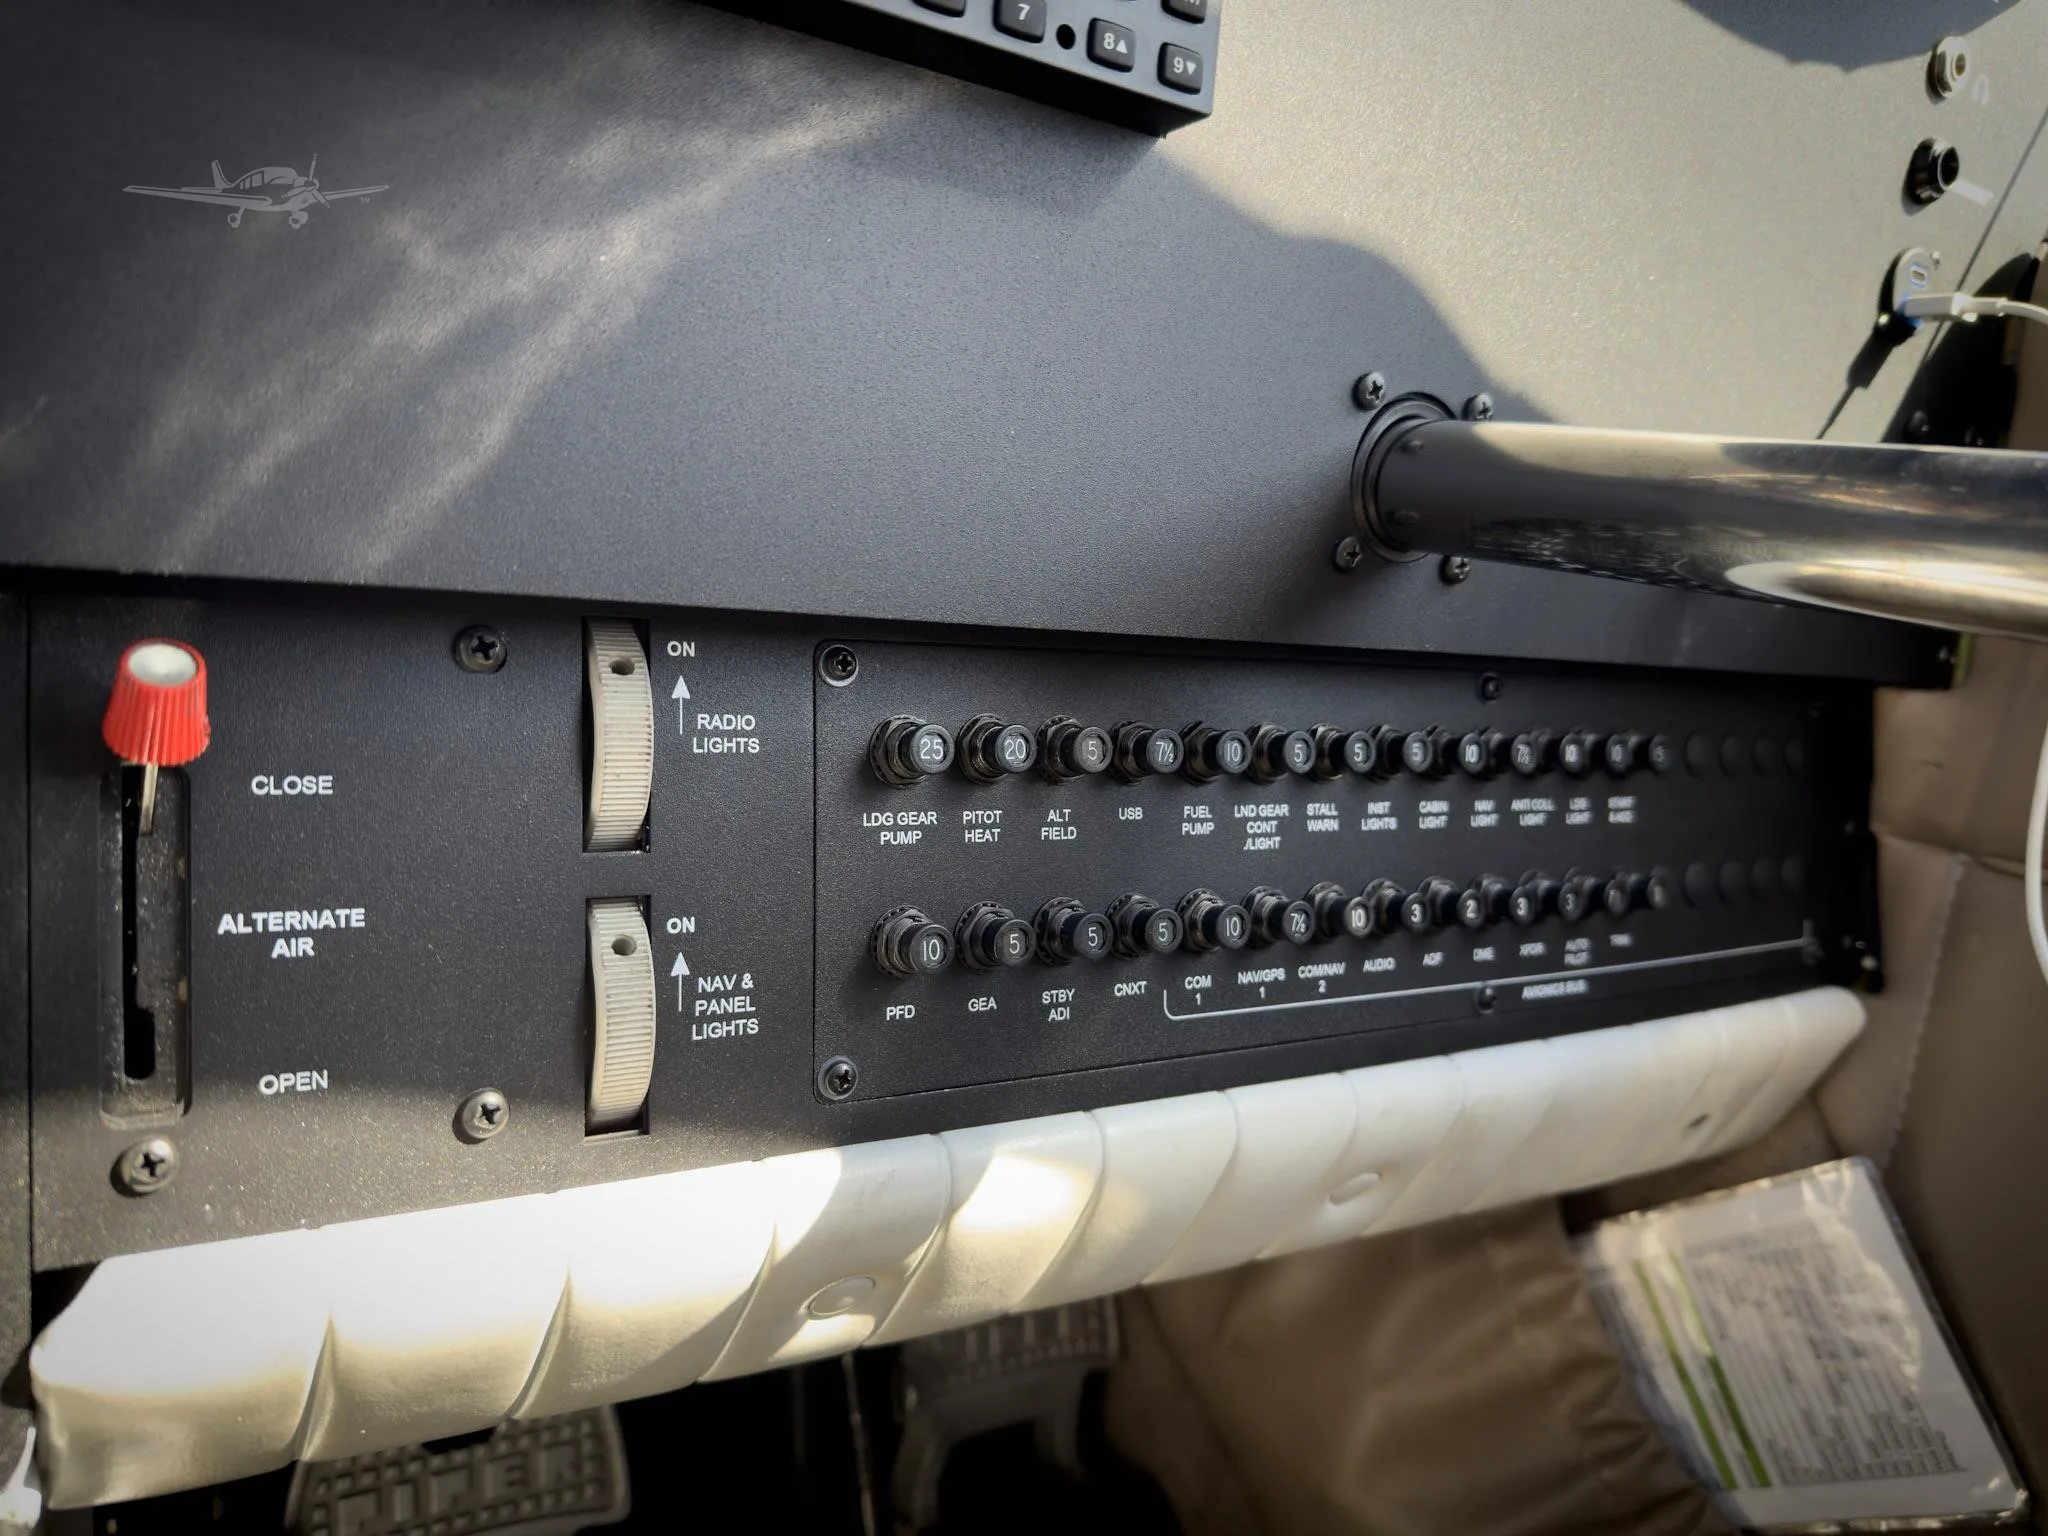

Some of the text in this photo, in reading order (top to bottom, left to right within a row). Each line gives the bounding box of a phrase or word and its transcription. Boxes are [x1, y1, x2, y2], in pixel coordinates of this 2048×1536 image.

[1019, 4, 1030, 20] 7
[1104, 33, 1115, 49] 8
[1174, 57, 1183, 73] 9
[667, 641, 695, 657] ON
[698, 714, 755, 730] RADIO
[693, 736, 759, 754] LIGHTS
[920, 736, 943, 760] 25
[1005, 736, 1025, 759] 20
[1088, 741, 1097, 760] 5
[1228, 743, 1240, 761] 10
[1294, 744, 1302, 762] 5
[1354, 744, 1362, 761] 5
[1413, 743, 1421, 761] 5
[1466, 745, 1478, 763] 10
[252, 775, 333, 795] CLOSE
[1047, 809, 1071, 822] ALT
[1119, 807, 1143, 819] USB
[1184, 806, 1212, 818] FUEL
[1235, 804, 1288, 817] LND GEAR
[1307, 803, 1338, 816] STALL
[1368, 802, 1390, 814] INST
[863, 812, 937, 826] LDG GEAR
[963, 811, 1002, 824] PITOT
[1307, 819, 1338, 831] WARN
[1362, 817, 1397, 830] LIGHTS
[1419, 815, 1447, 829] LIGHT
[1471, 814, 1498, 827] LIGHT
[1042, 827, 1076, 840] FIELD
[1182, 822, 1214, 835] PUMP
[1247, 821, 1277, 833] CONT
[881, 831, 922, 845] PUMP
[965, 829, 1000, 842] HEAT
[218, 908, 365, 934] ALTERNATE
[1352, 909, 1364, 927] 10
[1411, 904, 1421, 922] 3
[667, 917, 695, 934] ON
[1159, 923, 1168, 941] 5
[1227, 917, 1239, 936] 10
[1010, 934, 1019, 953] 5
[1089, 927, 1097, 946] 5
[272, 937, 314, 958] AIR
[924, 939, 940, 960] 10
[1298, 963, 1345, 978] COM/NAV
[1363, 958, 1395, 971] AUDIO
[699, 973, 753, 993] NAV &
[1185, 975, 1211, 989] COM
[1238, 968, 1285, 984] NAV/GPS
[1114, 981, 1147, 996] CNXT
[1259, 986, 1264, 998] 1
[1319, 980, 1325, 992] 2
[968, 997, 997, 1011] GEA
[1043, 989, 1075, 1003] STBY
[1196, 993, 1200, 1005] 1
[696, 996, 756, 1016] PANEL
[887, 1005, 915, 1020] PFD
[1048, 1007, 1069, 1021] ADI
[692, 1018, 759, 1040] LIGHTS
[259, 1070, 328, 1096] OPEN
